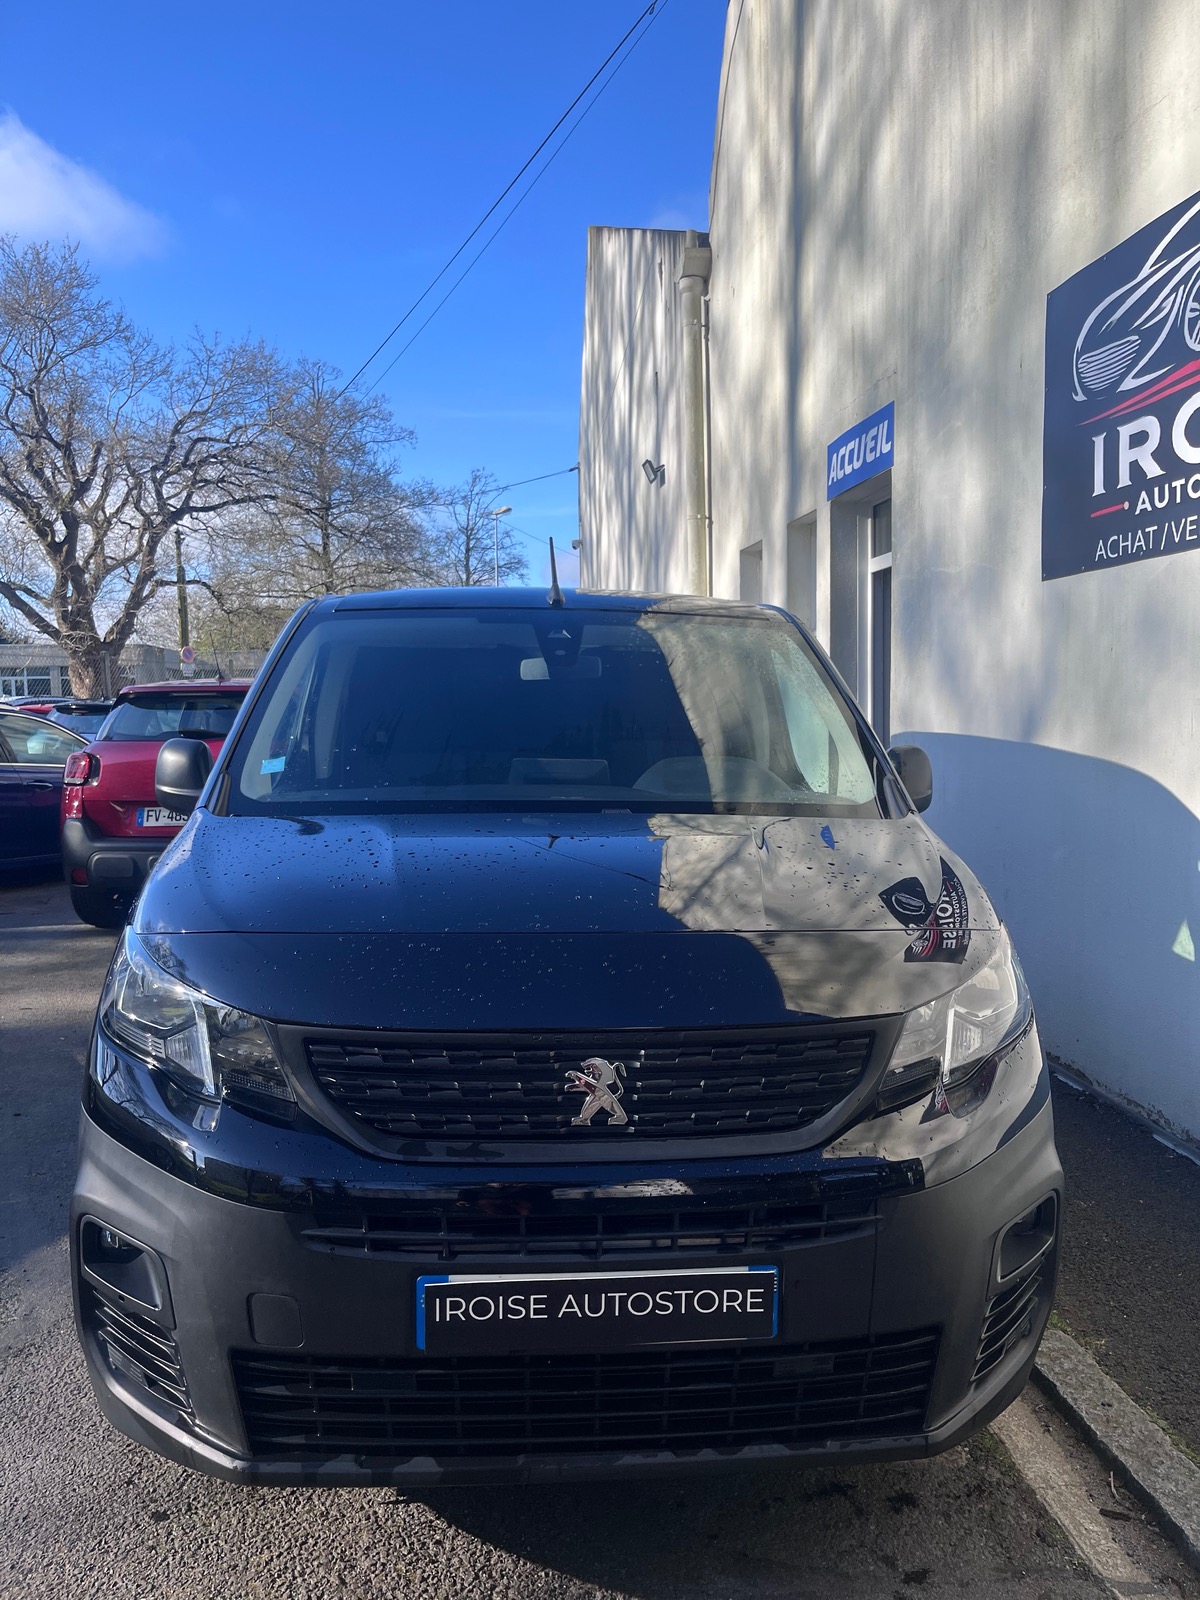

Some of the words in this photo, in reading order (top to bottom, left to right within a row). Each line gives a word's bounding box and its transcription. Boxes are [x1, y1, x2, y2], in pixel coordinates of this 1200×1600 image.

[828, 420, 892, 486] ACCUEIL
[530, 1033, 665, 1044] PEUGEOT
[435, 1294, 549, 1323] IROISE
[557, 1288, 766, 1319] AUTOSTORE
